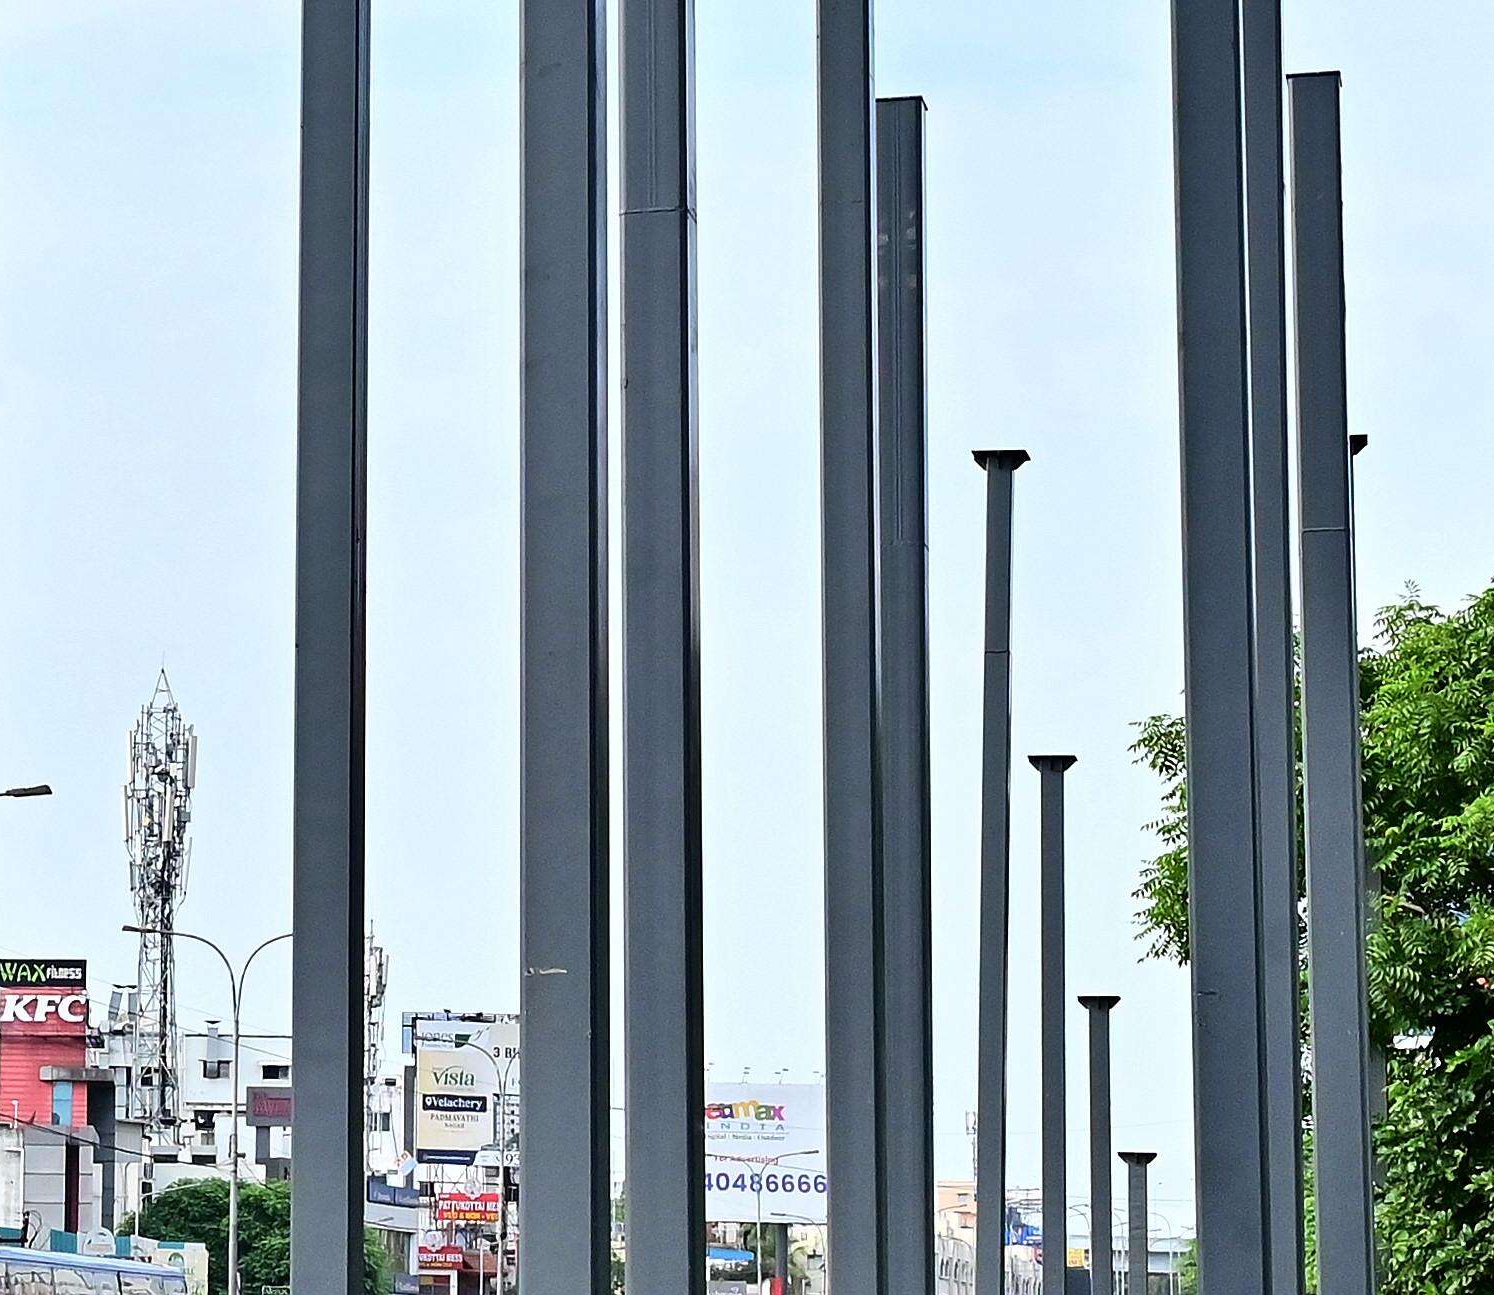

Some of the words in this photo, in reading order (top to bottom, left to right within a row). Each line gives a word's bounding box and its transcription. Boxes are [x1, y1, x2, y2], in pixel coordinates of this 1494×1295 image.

[0, 963, 46, 982] WAX
[0, 994, 87, 1022] KFC
[433, 1068, 475, 1086] Vista
[432, 1097, 483, 1110] Velachery
